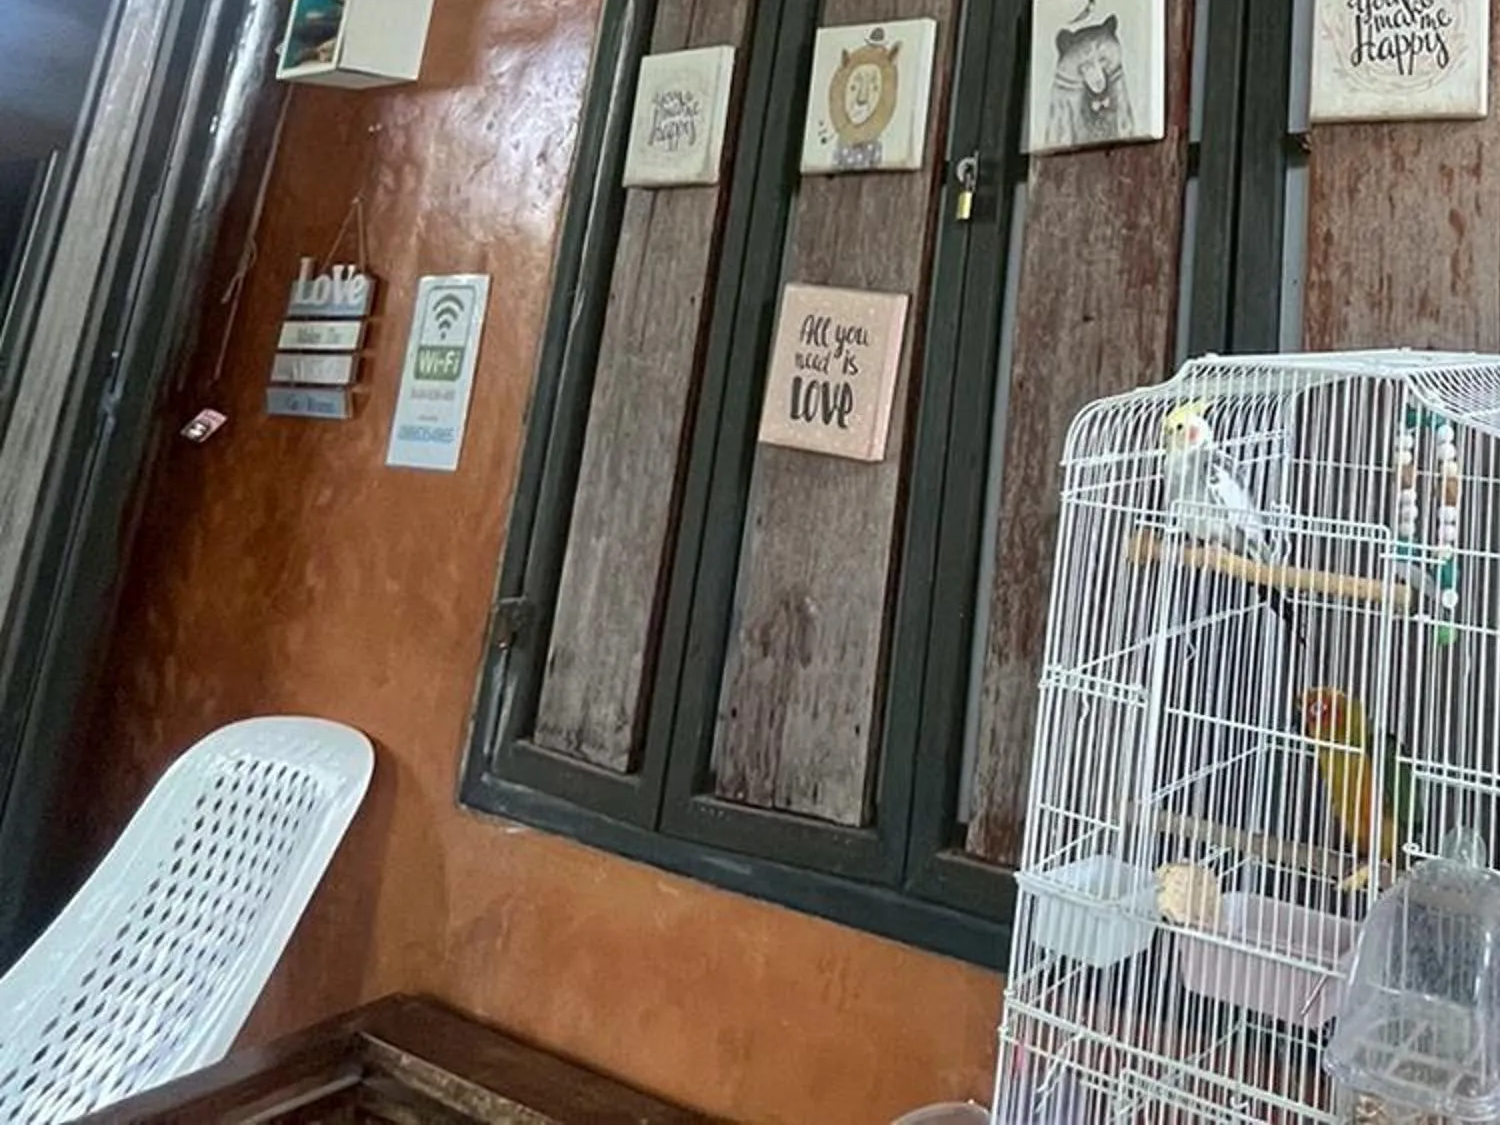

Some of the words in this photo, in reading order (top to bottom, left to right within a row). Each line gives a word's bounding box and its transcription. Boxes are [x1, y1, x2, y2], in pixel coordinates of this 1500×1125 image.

[1420, 8, 1453, 31] me
[1351, 15, 1449, 75] Happy
[800, 315, 831, 348] All
[834, 324, 869, 358] you
[418, 350, 461, 375] Wi-Fi
[843, 350, 859, 375] is
